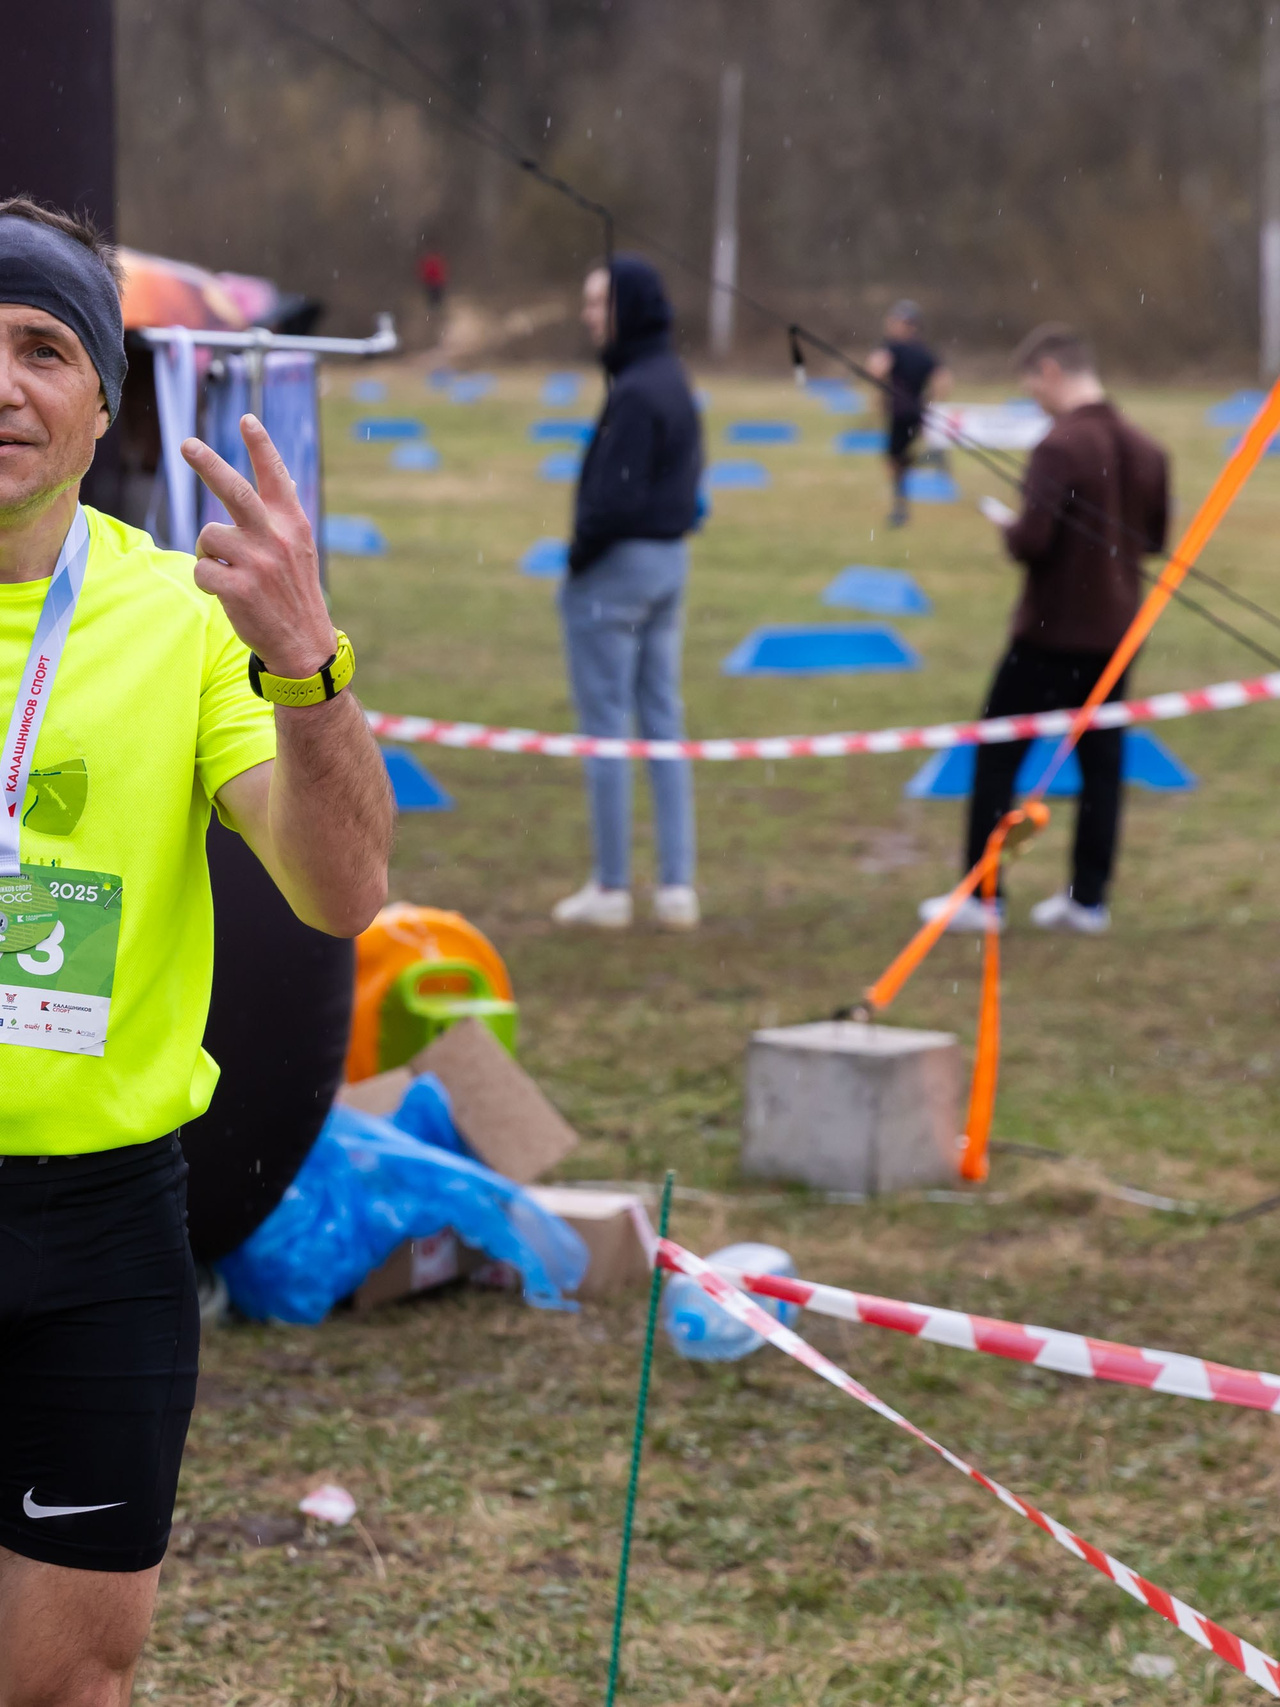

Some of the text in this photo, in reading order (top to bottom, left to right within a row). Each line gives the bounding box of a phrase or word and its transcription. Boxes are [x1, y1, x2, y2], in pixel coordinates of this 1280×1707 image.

[6, 655, 51, 792] КАЛАШНИКОВ СПОРТ
[15, 884, 32, 893] СПОРТ
[49, 881, 99, 903] 2025
[52, 1003, 92, 1013] КАЛАШНИКОВ
